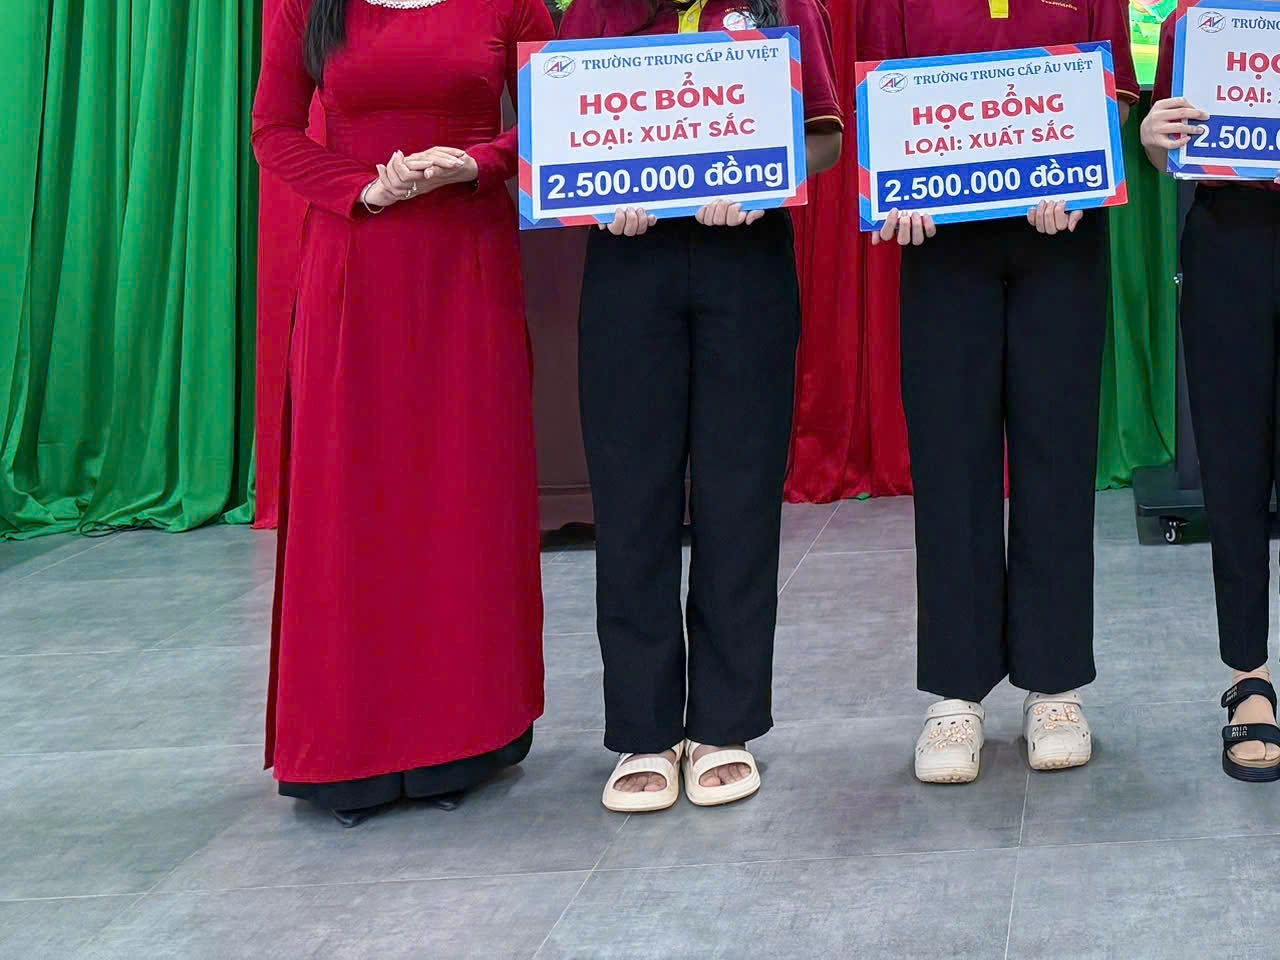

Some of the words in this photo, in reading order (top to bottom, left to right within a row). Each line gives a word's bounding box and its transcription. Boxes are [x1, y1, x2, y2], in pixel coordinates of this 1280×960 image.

[582, 53, 641, 70] TRƯỜNG
[644, 53, 693, 66] TRUNG
[696, 48, 723, 63] CẤP
[725, 47, 744, 61] ÂU
[746, 45, 779, 61] VIỆT
[913, 69, 968, 85] TRƯỜNG
[970, 67, 1015, 81] TRUNG
[1018, 62, 1042, 77] CẤP
[1044, 61, 1061, 74] ÂU
[1063, 58, 1093, 73] VIỆT
[579, 91, 647, 121] HỌC
[655, 72, 745, 110] BỔNG
[912, 102, 975, 130] HỌC
[981, 84, 1064, 120] BỔNG
[1216, 85, 1272, 107] LOẠI:
[570, 127, 633, 150] LOẠI:
[640, 117, 701, 142] XUẤT
[709, 112, 756, 137] SẮC
[904, 137, 962, 157] LOẠI:
[969, 125, 1025, 149] XUẤT
[1032, 120, 1075, 142] SẮC
[547, 164, 695, 200] 2.500.000
[704, 155, 783, 187] đồng
[884, 167, 1020, 203] 2.500.000
[1029, 159, 1102, 188] đồng
